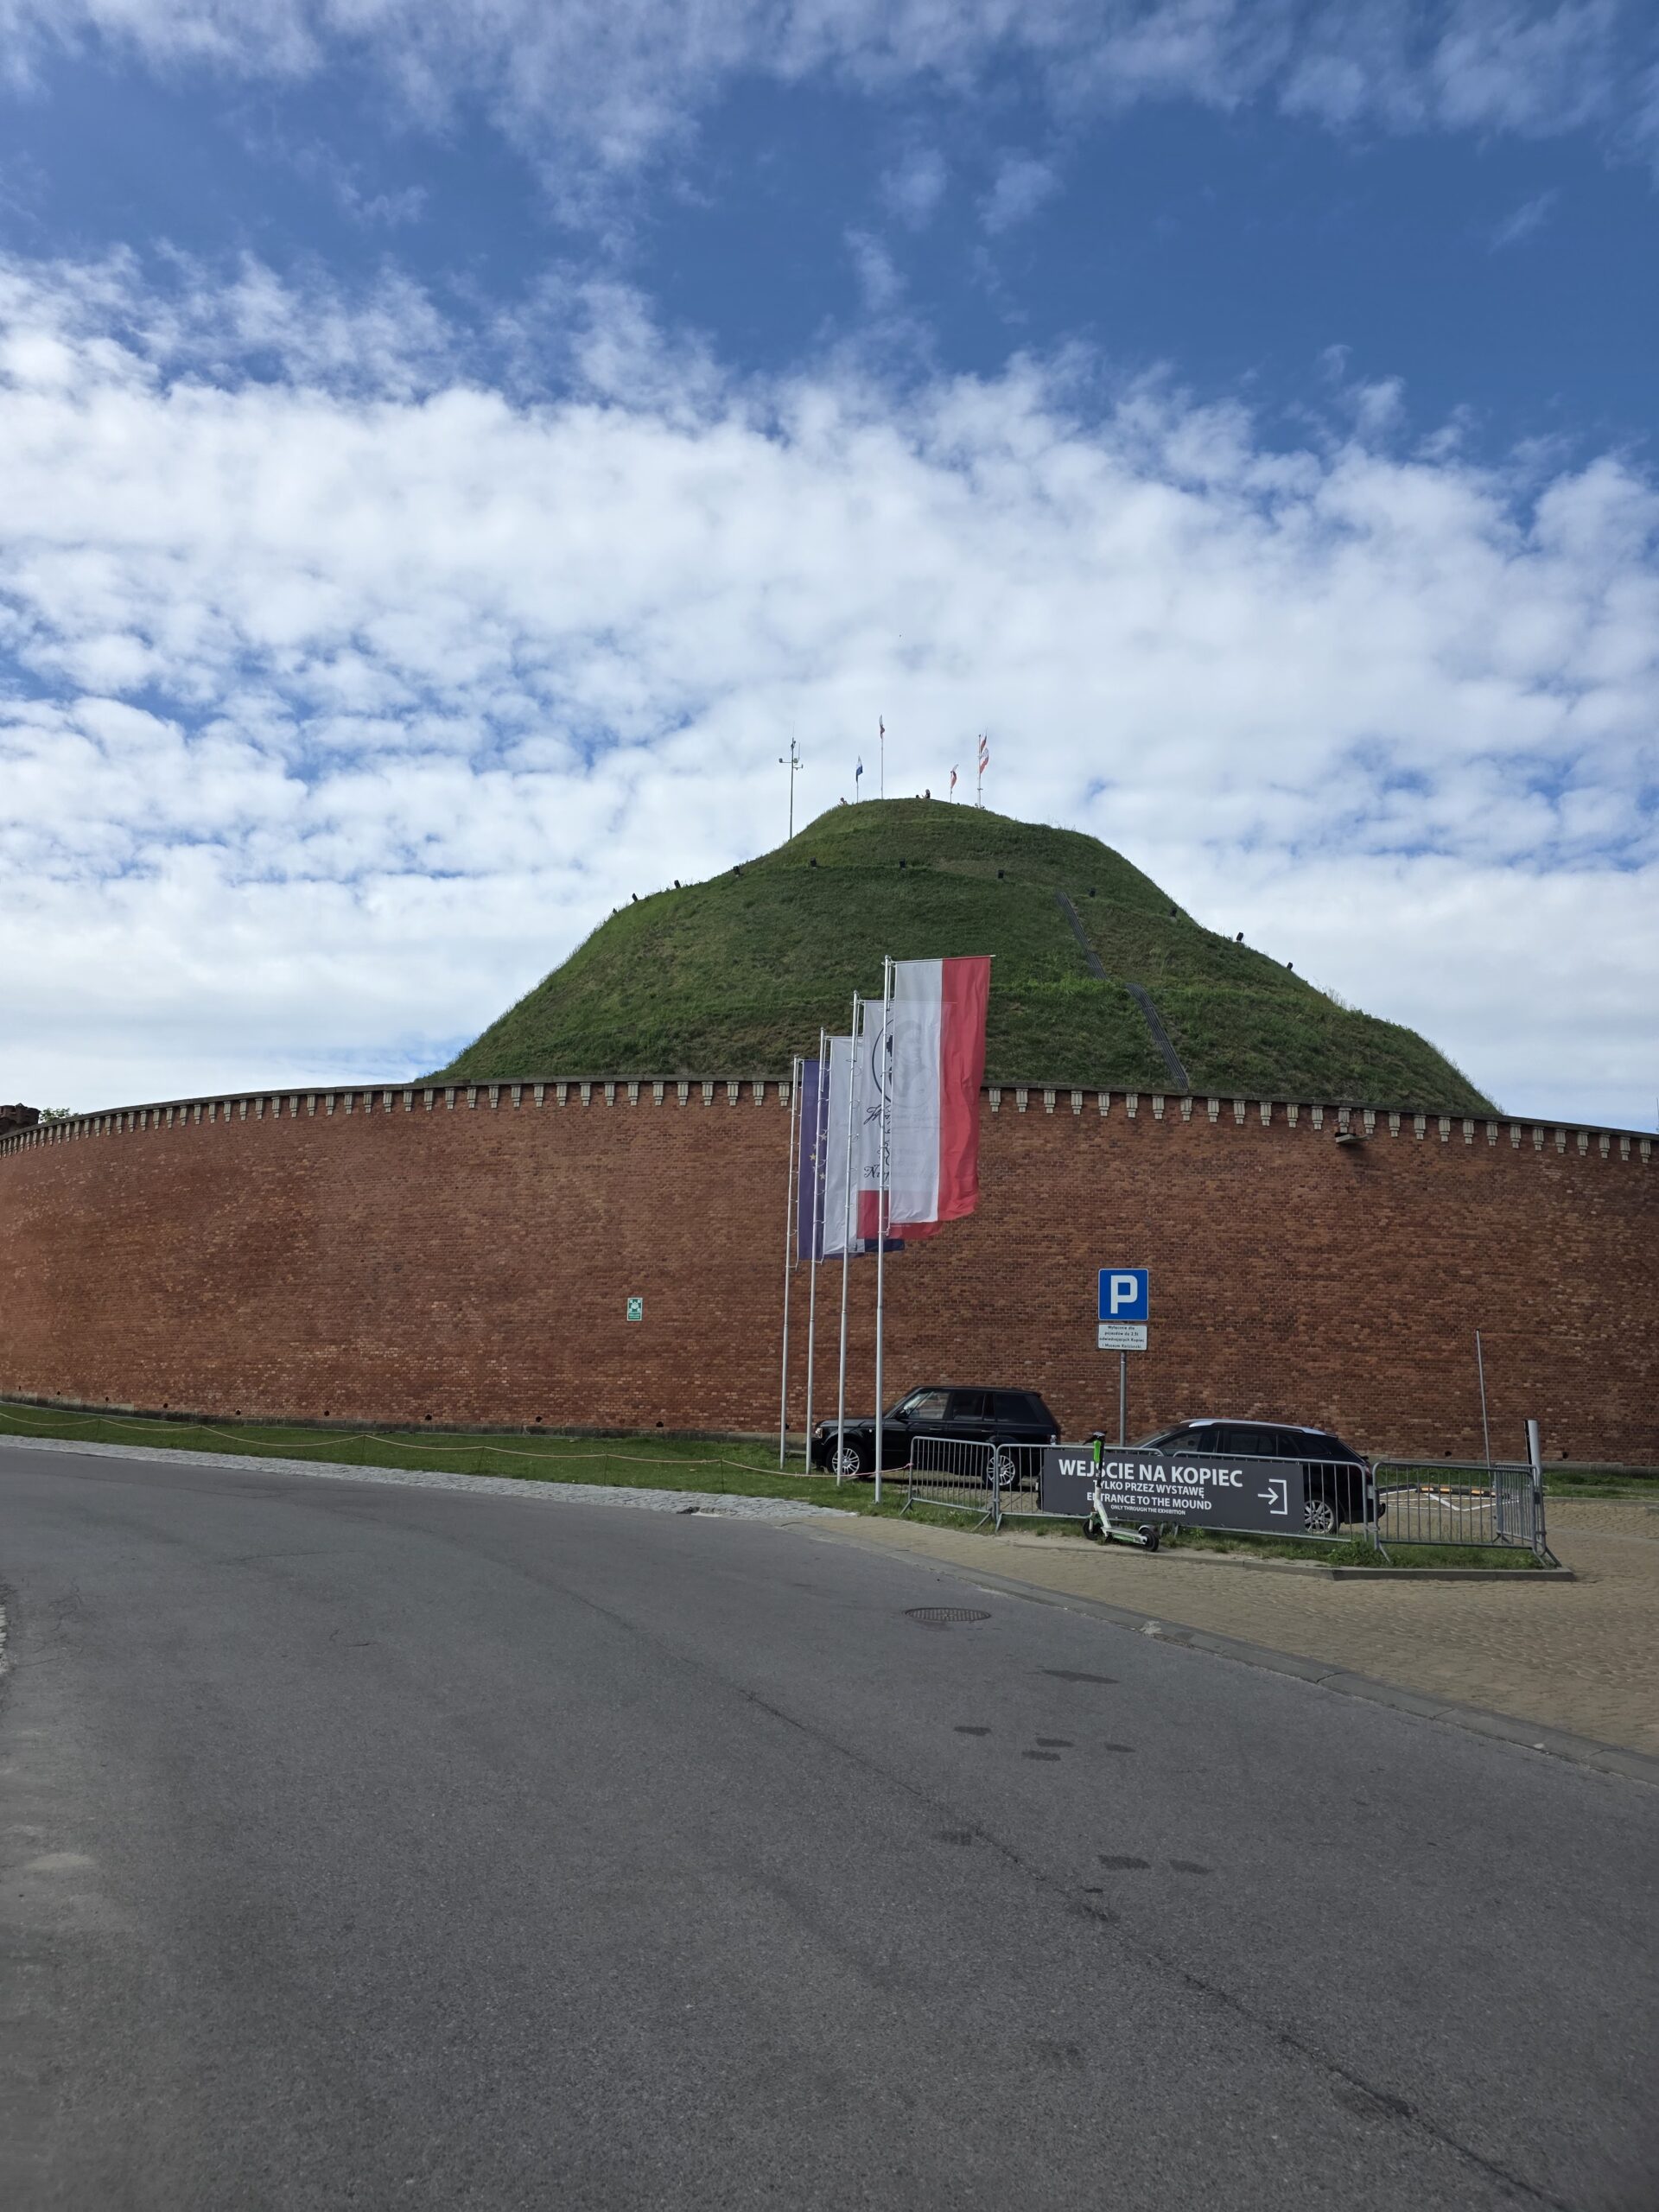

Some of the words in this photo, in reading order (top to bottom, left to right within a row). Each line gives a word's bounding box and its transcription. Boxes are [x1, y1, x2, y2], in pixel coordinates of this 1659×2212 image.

[1110, 1274, 1138, 1314] P
[1139, 1464, 1166, 1482] NA
[1171, 1465, 1243, 1487] KOPIEC
[1125, 1482, 1155, 1493] PRZEZ
[1156, 1484, 1205, 1498] WYSTAWĘ
[1137, 1496, 1150, 1505] TO
[1151, 1497, 1170, 1507] THE
[1172, 1498, 1212, 1510] MOUND
